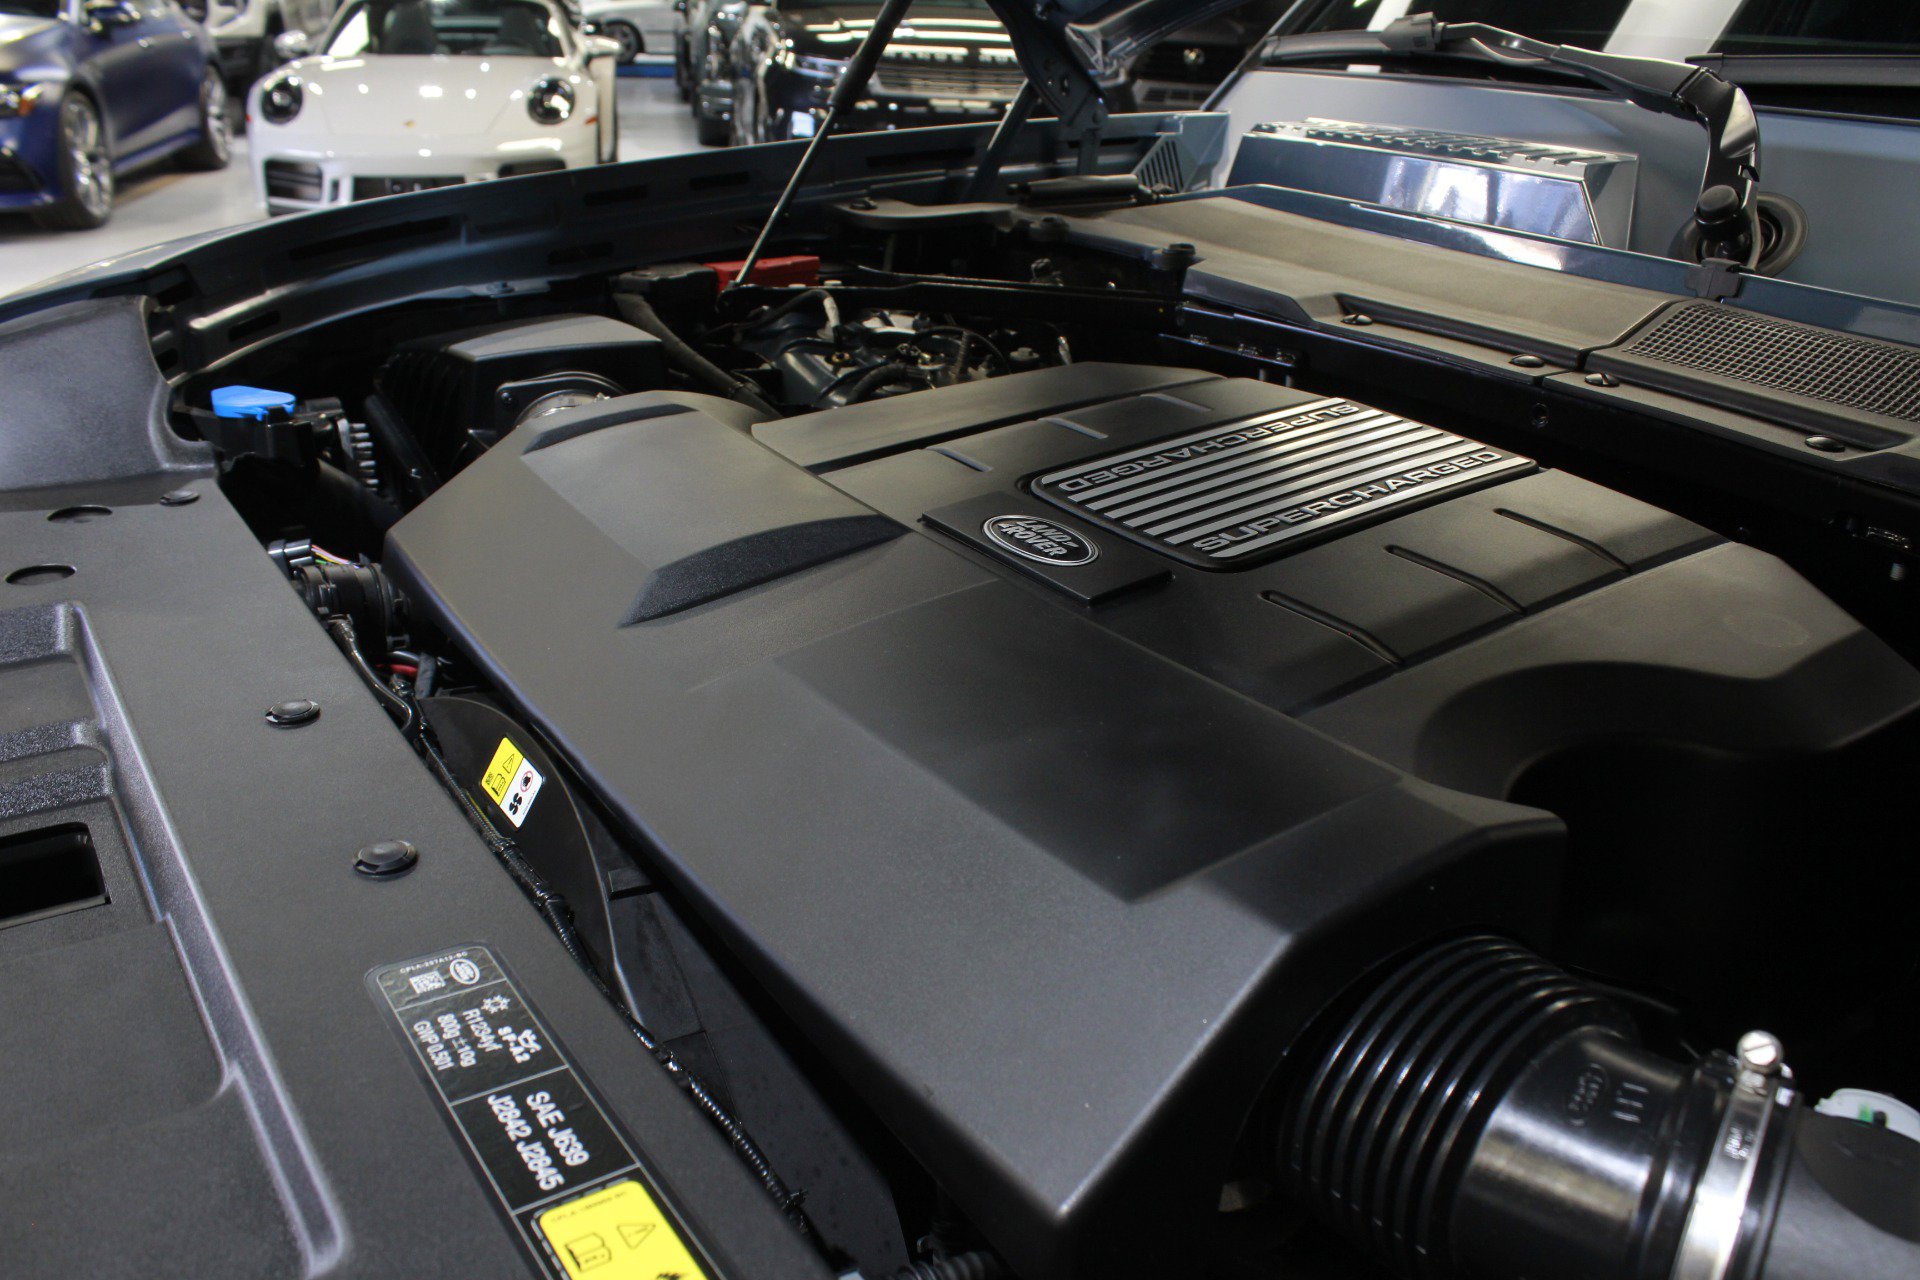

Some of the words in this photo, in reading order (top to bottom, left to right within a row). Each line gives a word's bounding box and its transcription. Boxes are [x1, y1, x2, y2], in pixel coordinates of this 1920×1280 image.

[1058, 403, 1360, 493] SUPERCHARGED
[1192, 451, 1503, 552] SUPERCHARGED
[1001, 524, 1068, 556] ROVER
[1016, 520, 1073, 542] LAND
[413, 1020, 440, 1044] GWP
[437, 1012, 461, 1040] 800g
[462, 1008, 503, 1052] R1234yf
[426, 1043, 455, 1070] 0.501
[487, 1094, 533, 1142] J2842
[516, 1140, 565, 1190] J2845
[526, 1091, 565, 1128] SAE
[547, 1127, 590, 1167] J639
